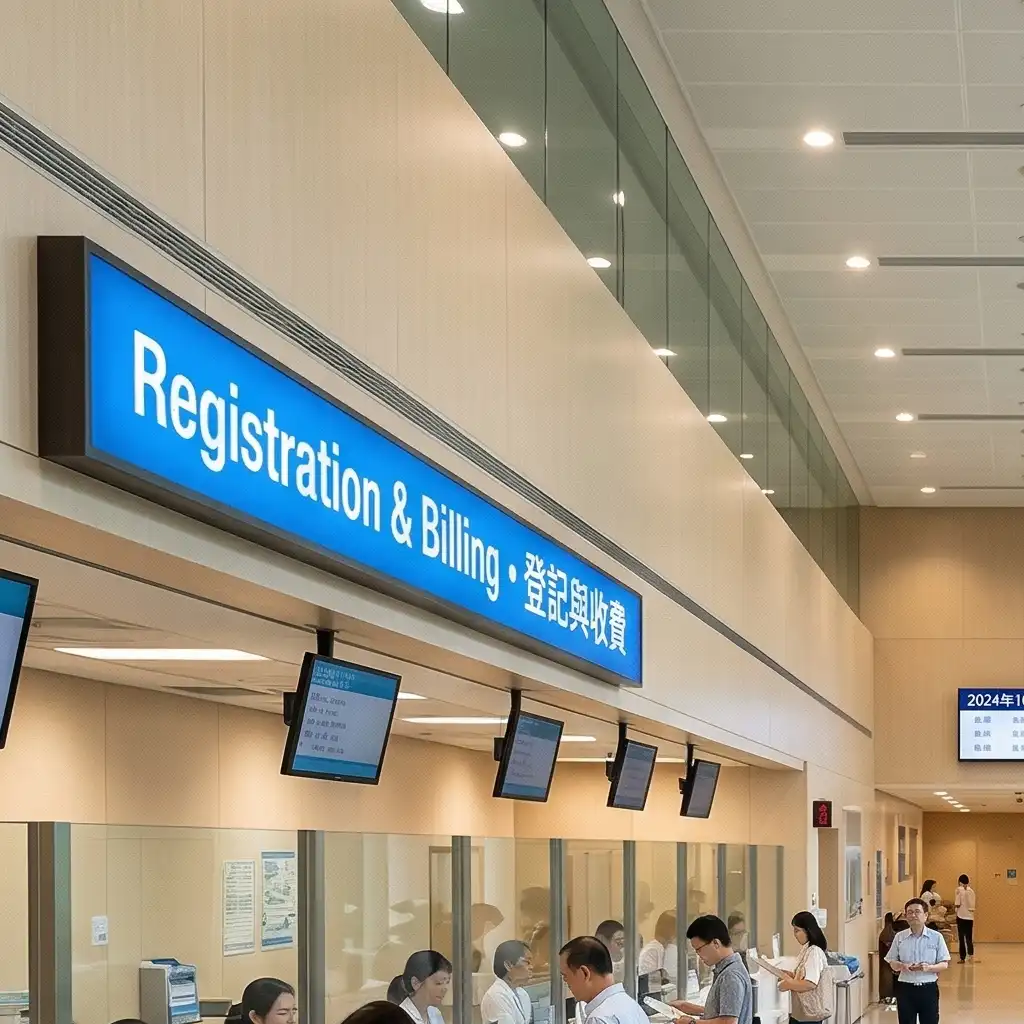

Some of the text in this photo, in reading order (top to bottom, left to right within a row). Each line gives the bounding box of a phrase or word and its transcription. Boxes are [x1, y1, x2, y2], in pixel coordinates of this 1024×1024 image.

[133, 329, 381, 532] Registration
[390, 480, 413, 549] &
[421, 494, 500, 602] Billing
[523, 551, 627, 656] 登記與收費
